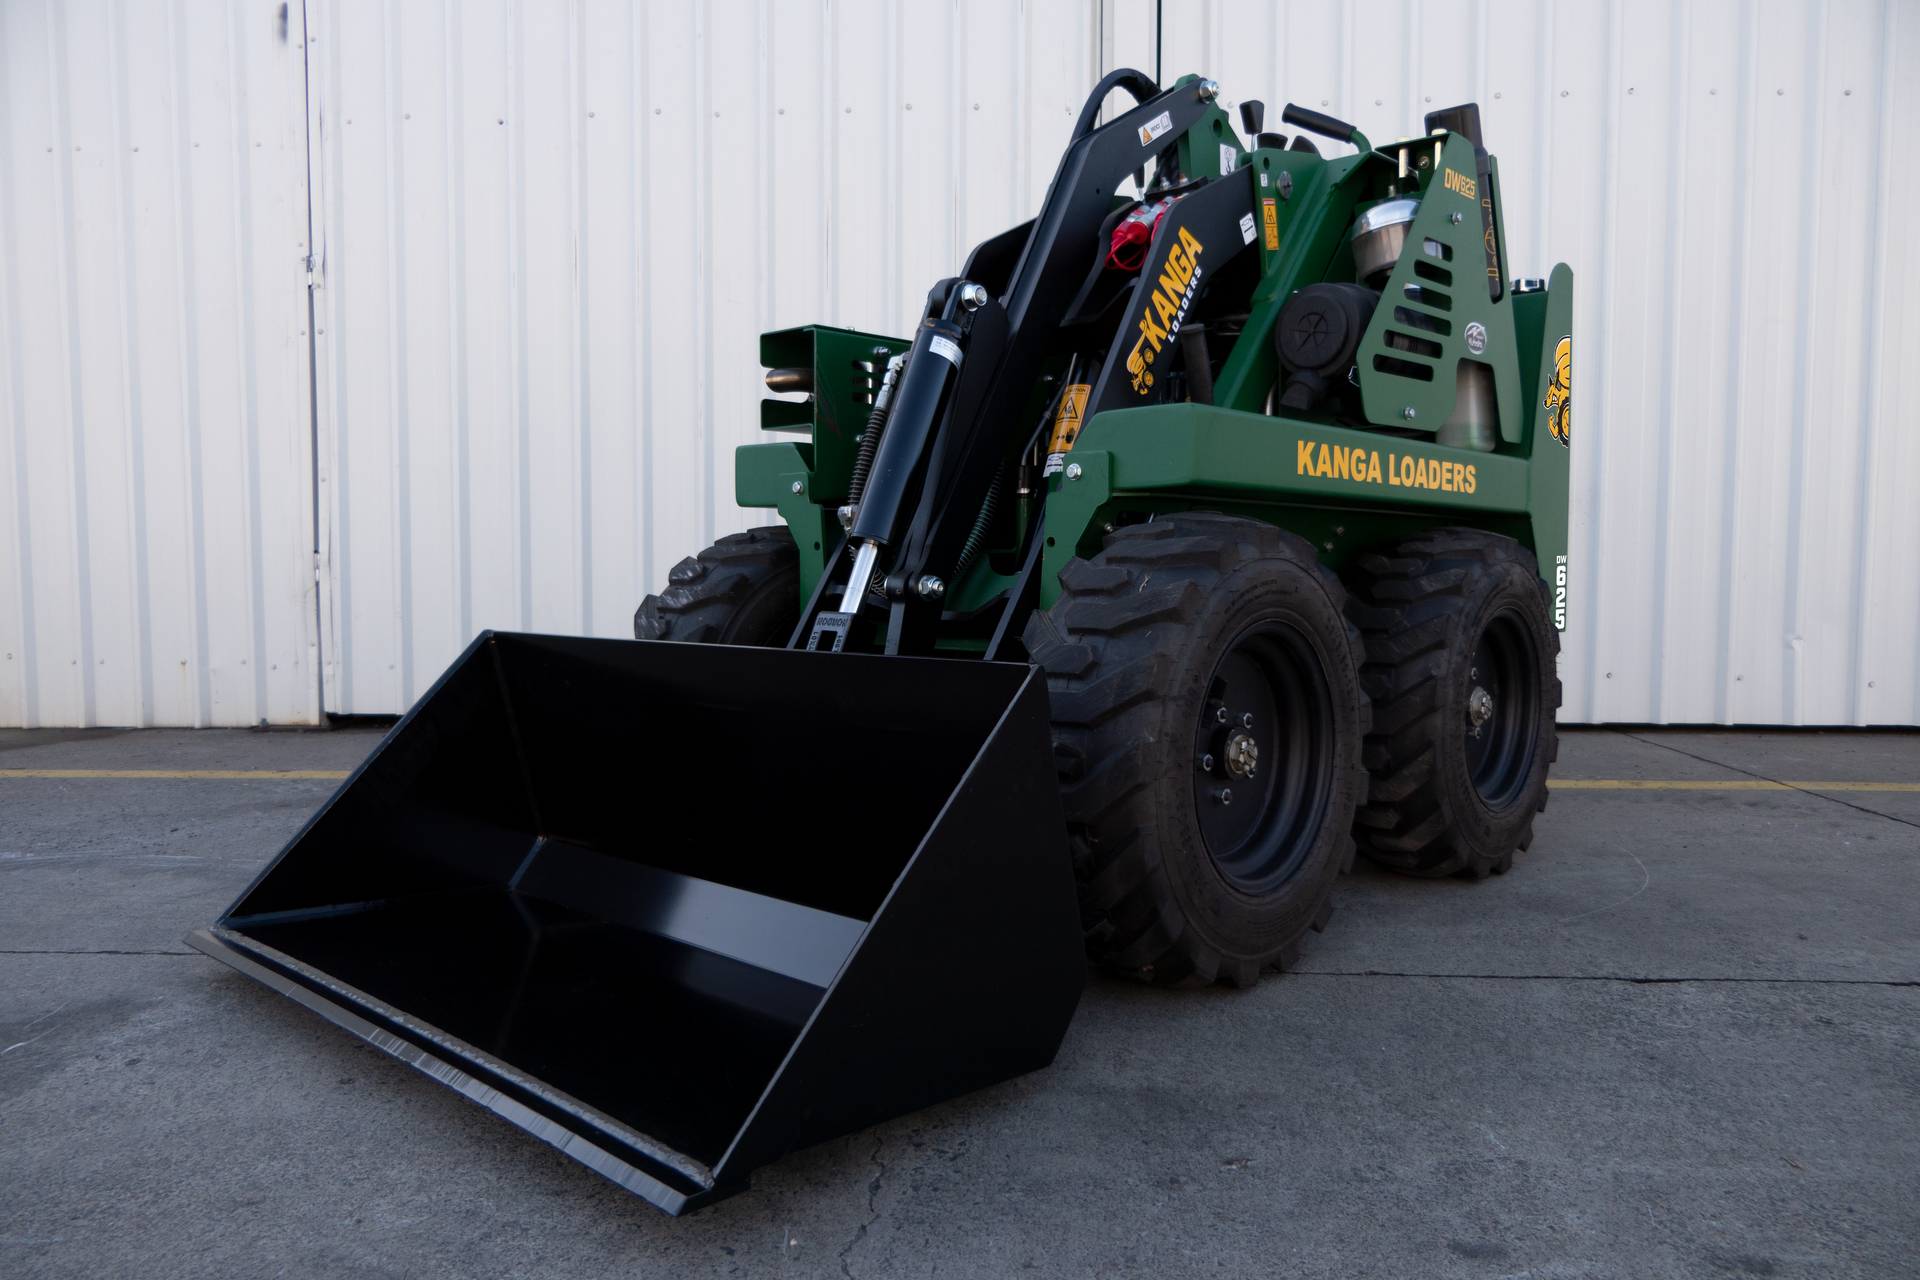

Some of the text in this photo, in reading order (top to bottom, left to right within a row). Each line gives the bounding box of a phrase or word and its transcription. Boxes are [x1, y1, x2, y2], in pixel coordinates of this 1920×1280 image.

[1444, 167, 1475, 199] DW625
[1144, 225, 1203, 354] KANGA
[1167, 265, 1202, 344] LOADERS
[1297, 440, 1476, 494] KANGA LOADERS
[1556, 555, 1567, 564] DW
[1554, 565, 1567, 630] 625
